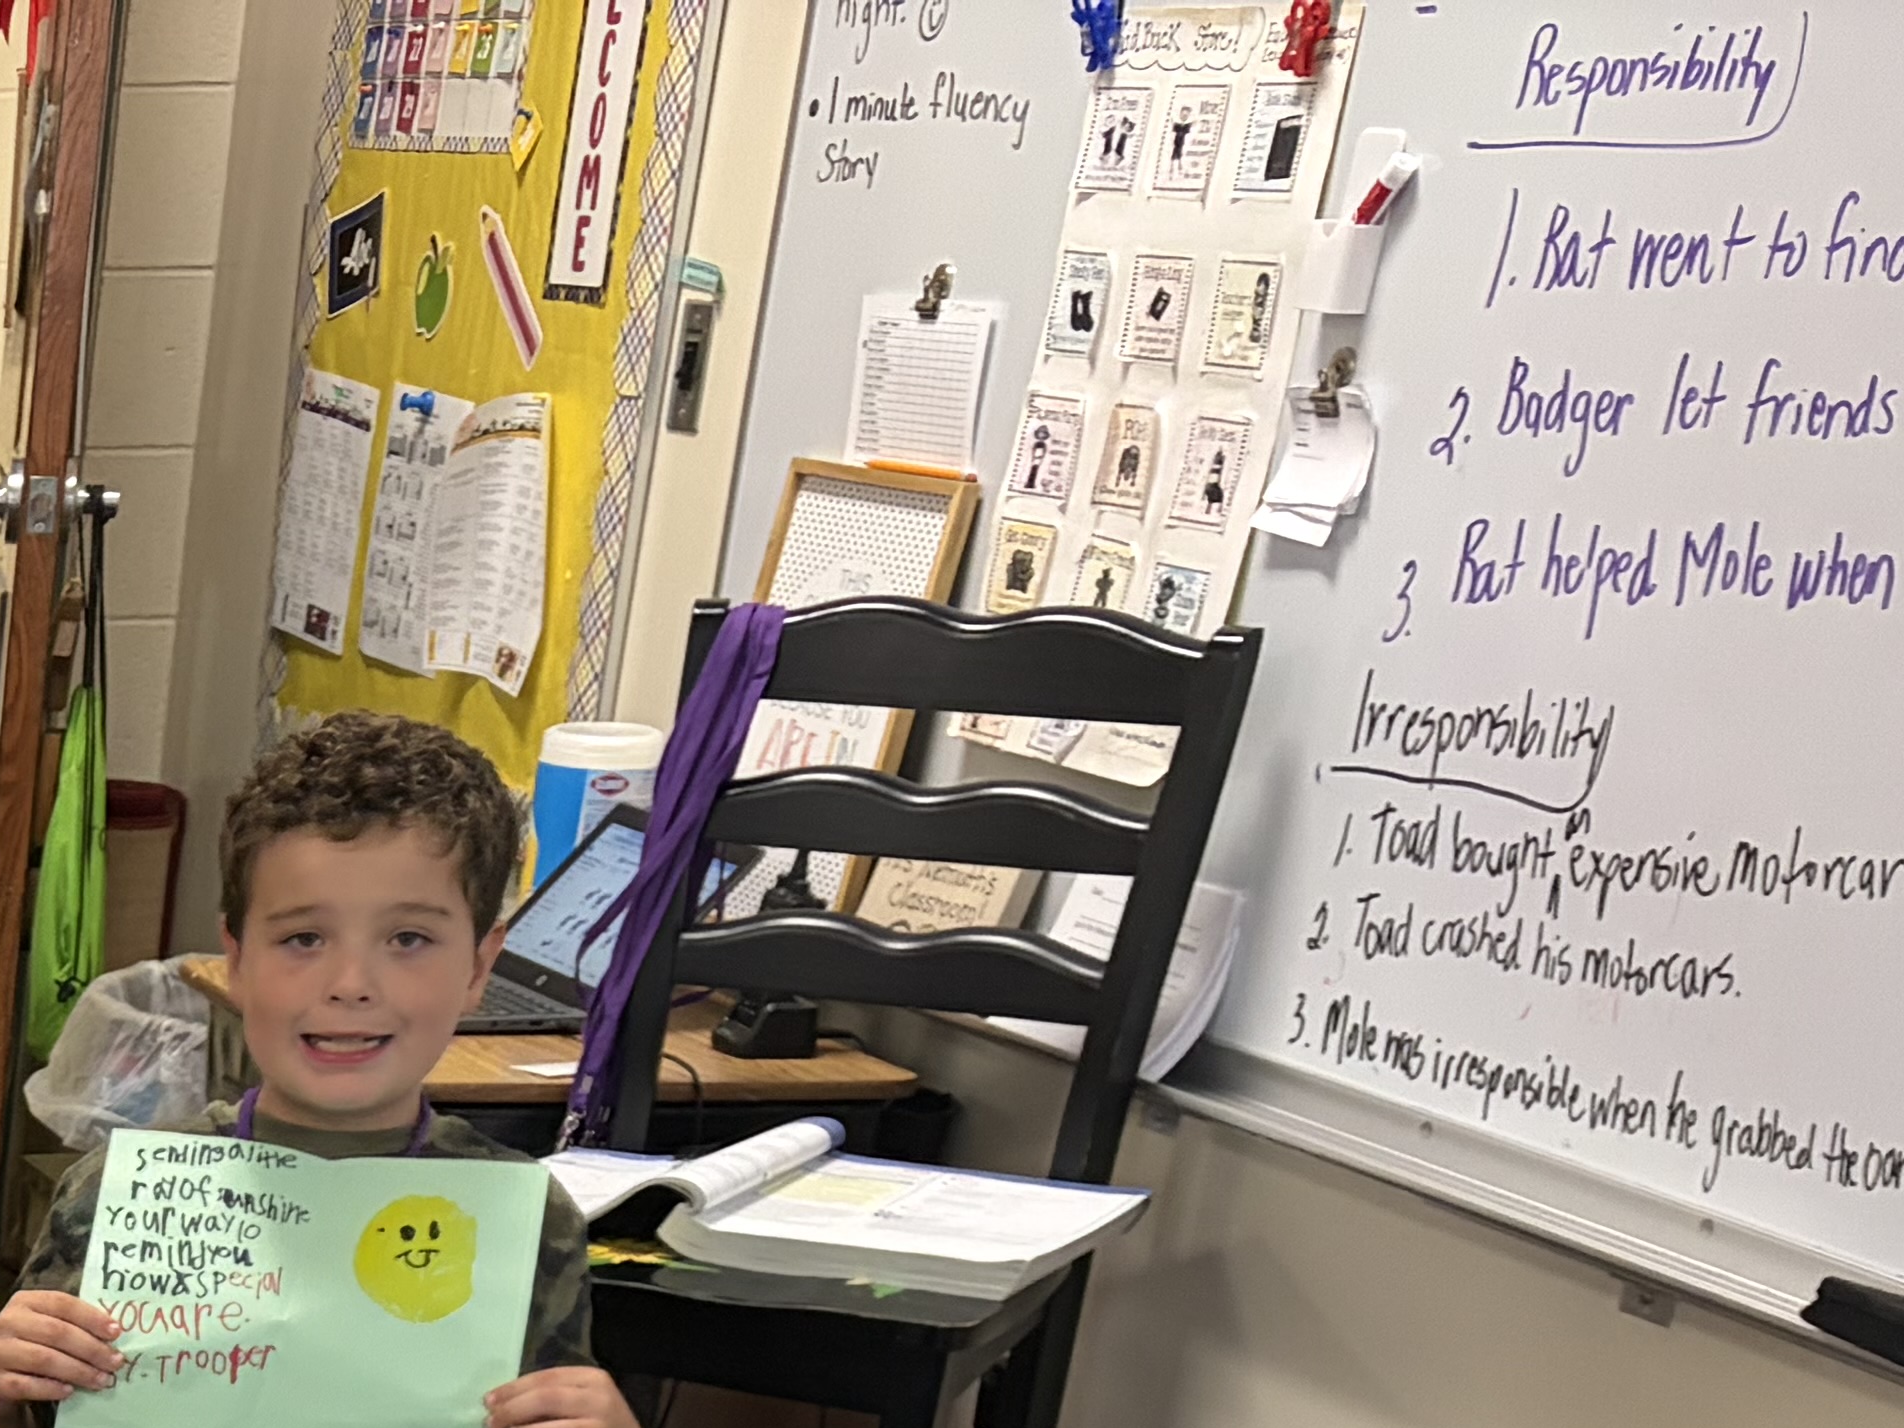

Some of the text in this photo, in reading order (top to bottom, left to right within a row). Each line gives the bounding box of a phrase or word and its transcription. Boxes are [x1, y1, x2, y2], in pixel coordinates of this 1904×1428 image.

[845, 82, 919, 123] minute
[930, 72, 1030, 150] fluency
[1516, 23, 1776, 135] Responsibility
[817, 139, 879, 190] Story
[1485, 188, 1807, 309] 1. Rat went to
[1429, 352, 1898, 478] 2. Badger let friends
[1381, 512, 1894, 643] 3. Rat helped Mole when
[1350, 669, 1616, 791] Irresponsibility
[1370, 801, 1442, 871] Toad
[1451, 810, 1557, 917] bought
[1568, 831, 1720, 921] expensive
[1306, 902, 1330, 950] 2.
[1355, 893, 1413, 961] Toad
[1421, 902, 1523, 971] crashed
[1531, 922, 1573, 982] his
[228, 1142, 245, 1160] a
[1320, 995, 1377, 1065] Mole
[1431, 1039, 1586, 1121] irresponsible
[1590, 1076, 1657, 1138] when
[1665, 1070, 1698, 1149] he
[1702, 1106, 1814, 1193] grabbed
[196, 1267, 283, 1299] special
